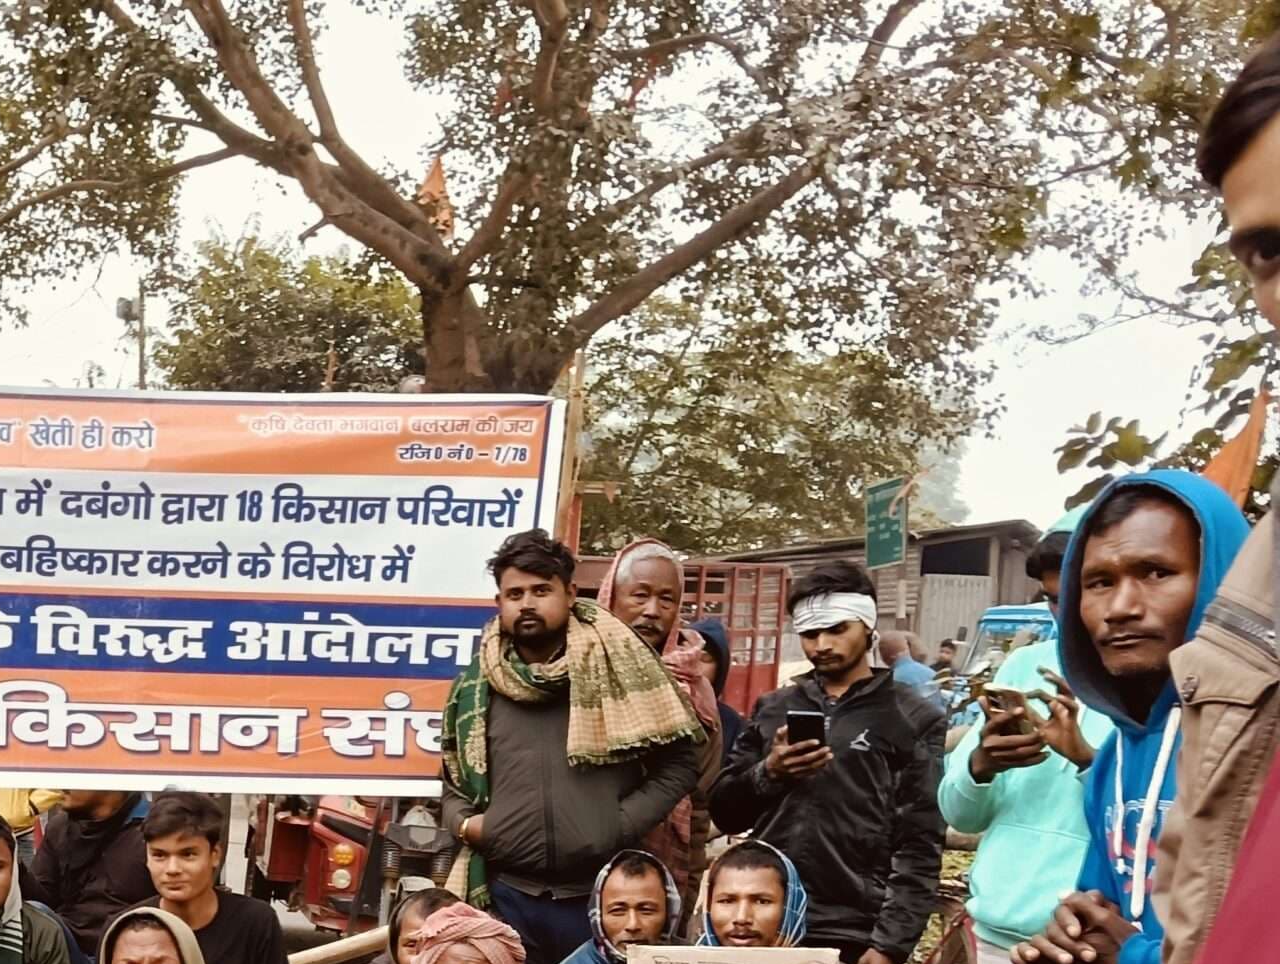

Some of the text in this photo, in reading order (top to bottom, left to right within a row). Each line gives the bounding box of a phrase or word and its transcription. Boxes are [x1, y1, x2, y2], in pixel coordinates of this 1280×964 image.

[29, 418, 74, 447] खेती
[81, 421, 105, 449] ही
[111, 421, 155, 448] करो
[339, 418, 399, 433] भगवान
[410, 418, 470, 433] बलराम
[475, 416, 498, 433] की
[504, 418, 533, 433] जय
[495, 446, 527, 461] 7/78
[14, 478, 52, 518] में
[60, 481, 154, 523] दबंगो
[161, 493, 228, 524] द्वारा
[236, 490, 263, 523] 18
[272, 484, 392, 525] किसान
[396, 485, 524, 528] परिवारों
[0, 535, 144, 580] बहिष्कार
[147, 541, 231, 582] करने
[237, 542, 275, 582] के
[281, 541, 374, 584] विरोध
[380, 544, 417, 585] में
[225, 612, 483, 667] आंदोलन
